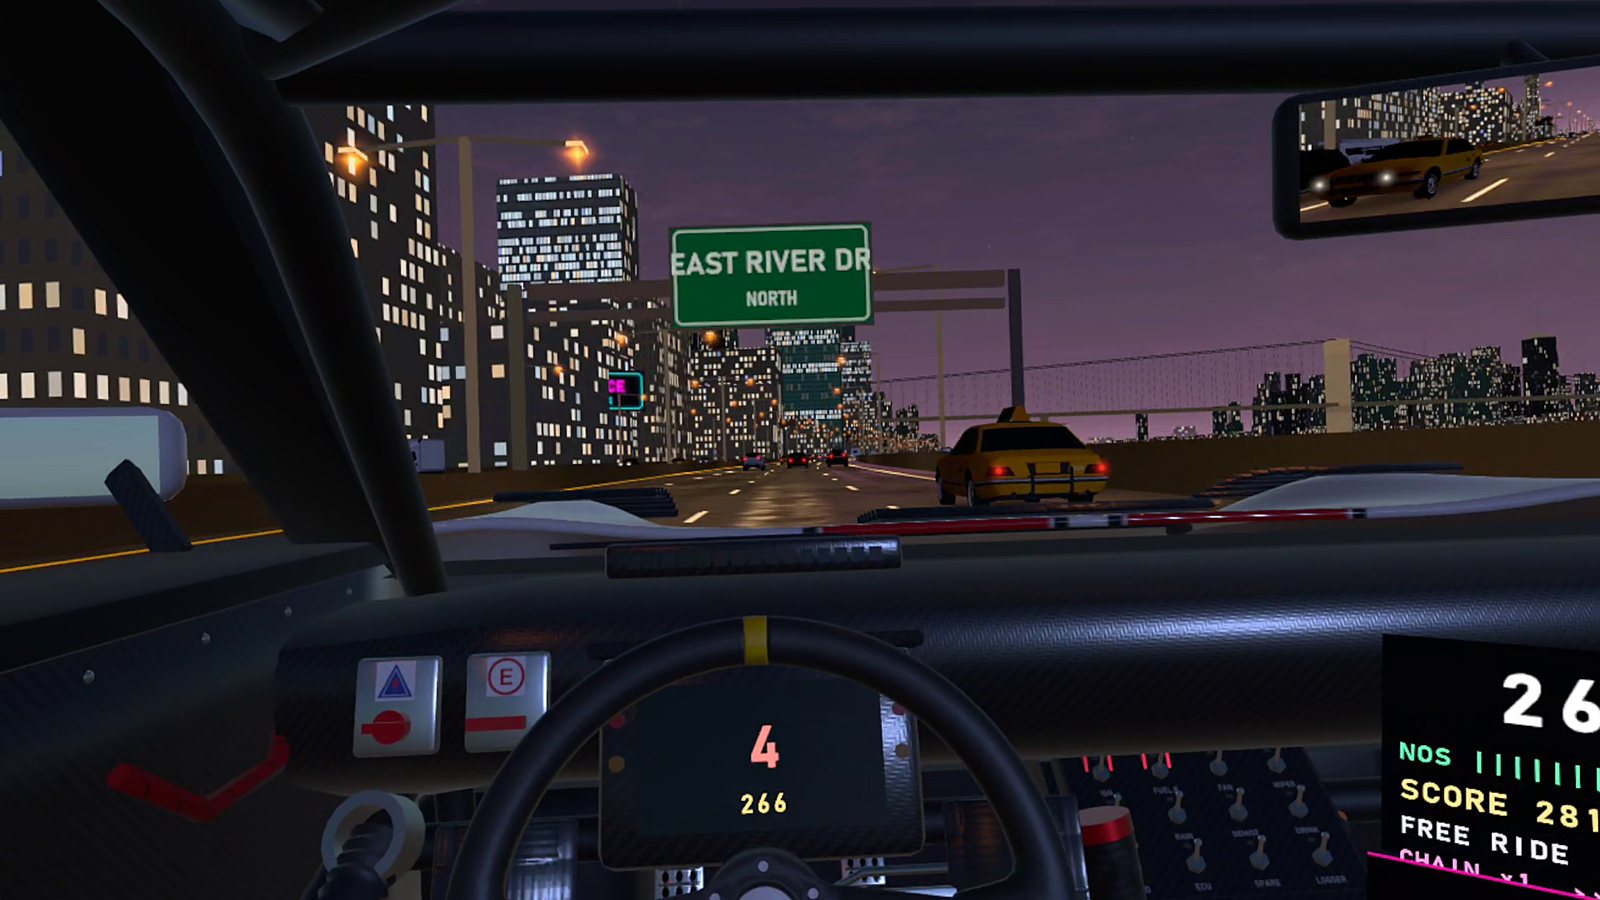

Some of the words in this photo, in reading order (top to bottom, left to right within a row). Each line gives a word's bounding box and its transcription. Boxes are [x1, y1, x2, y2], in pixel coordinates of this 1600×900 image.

[671, 250, 738, 276] EAST
[746, 249, 826, 273] RIVER
[835, 247, 871, 271] DR
[746, 290, 797, 307] NORTH
[500, 669, 513, 686] E
[1503, 672, 1600, 734] 26
[751, 725, 780, 769] 4
[1400, 741, 1452, 767] NOS
[741, 792, 787, 815] 266
[1401, 778, 1508, 817] SCORE
[1536, 800, 1599, 833] 281
[1401, 814, 1470, 846] FREE
[1491, 832, 1569, 865] RIDE
[1400, 849, 1480, 875] CHAIN
[1195, 882, 1213, 892] ECU
[1254, 878, 1281, 888] SPARE
